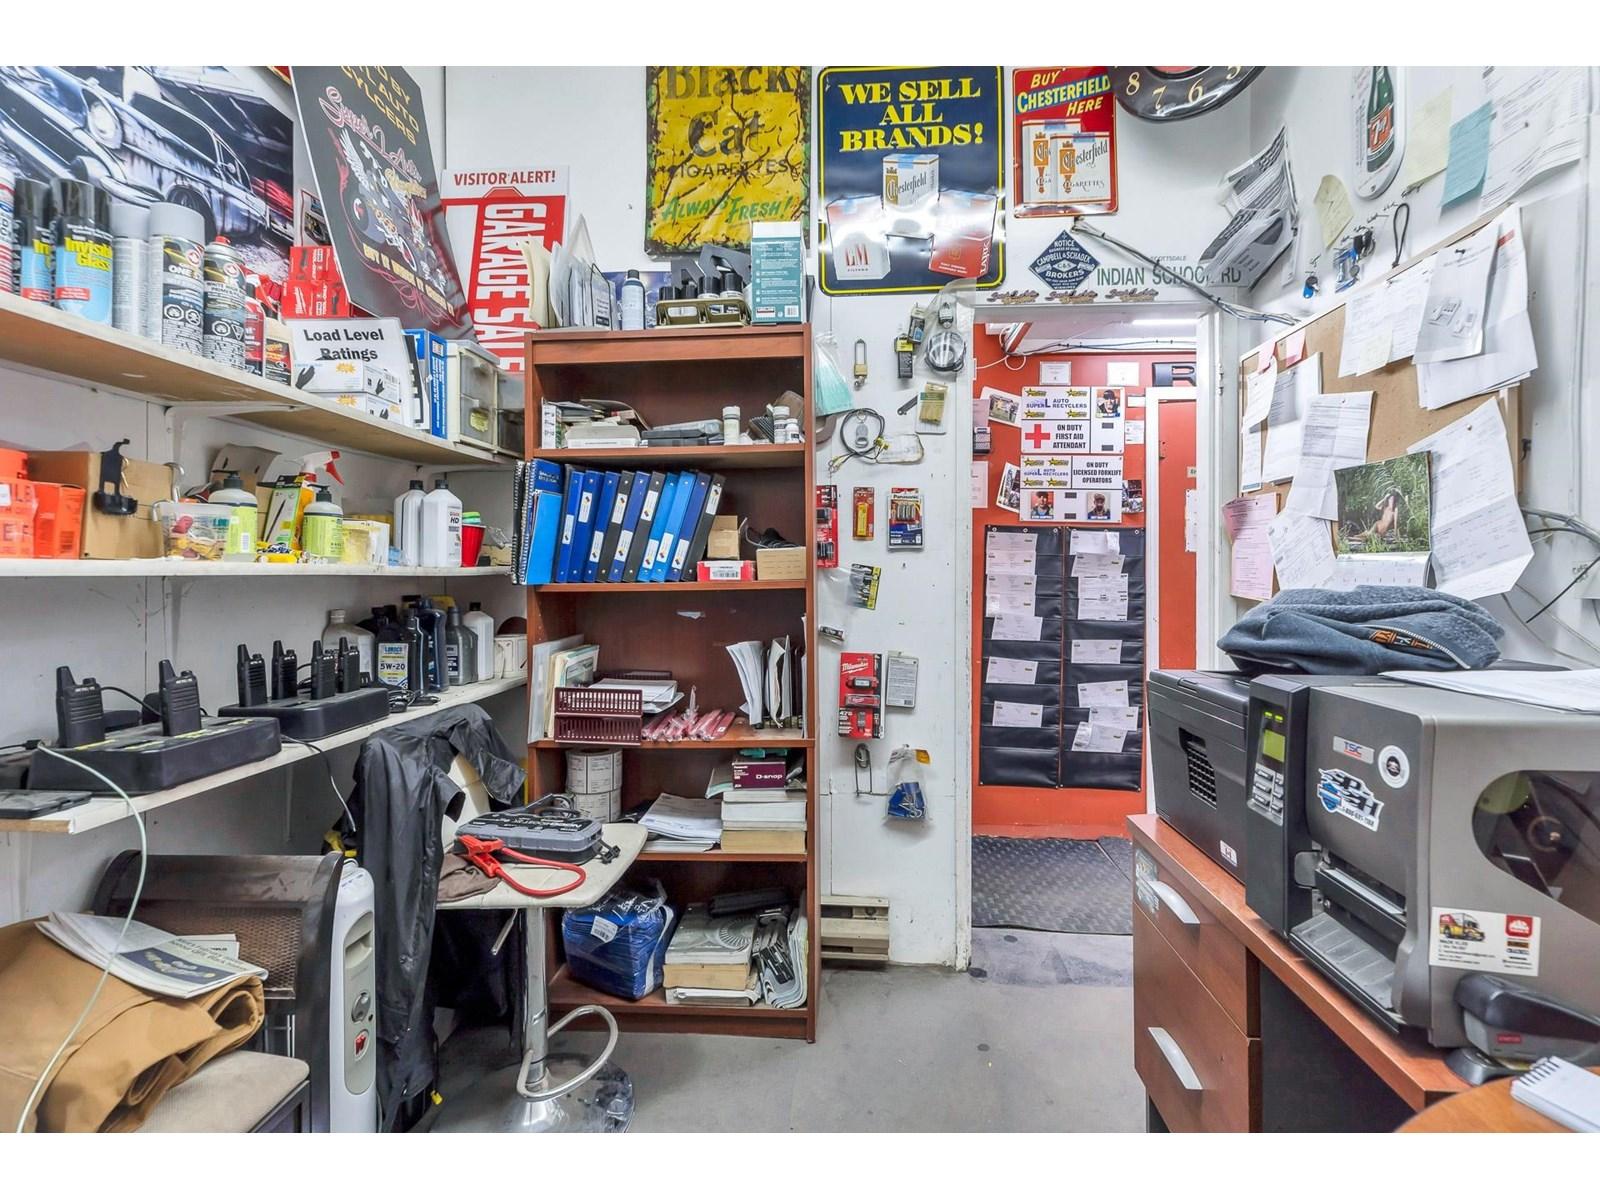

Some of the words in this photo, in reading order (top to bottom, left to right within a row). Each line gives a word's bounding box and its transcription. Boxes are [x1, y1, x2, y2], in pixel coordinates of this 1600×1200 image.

[664, 66, 795, 100] Black
[1030, 70, 1061, 89] BUY
[1125, 71, 1141, 96] 8
[838, 81, 892, 105] WE
[899, 77, 982, 102] SELL
[1017, 75, 1111, 113] CHESTERFIELD
[1152, 85, 1168, 110] 7
[1187, 77, 1204, 104] 6
[878, 102, 944, 126] ALL
[1066, 96, 1104, 117] HERE
[688, 110, 766, 157] Cat
[839, 122, 984, 153] BRANDS!
[454, 172, 508, 187] VISITOR
[510, 170, 556, 185] ALERT!
[668, 159, 790, 179] IGARETTES
[475, 203, 548, 300] GARAGE
[1053, 239, 1076, 248] NOTICE
[1045, 269, 1085, 279] BROKERS
[1096, 267, 1145, 286] INDIAN
[1220, 266, 1242, 284] RD
[303, 328, 341, 342] Load
[343, 327, 385, 341] Level
[319, 347, 379, 363] Ratings
[1052, 441, 1086, 449] ATTENDANT
[1343, 741, 1362, 753] TSC
